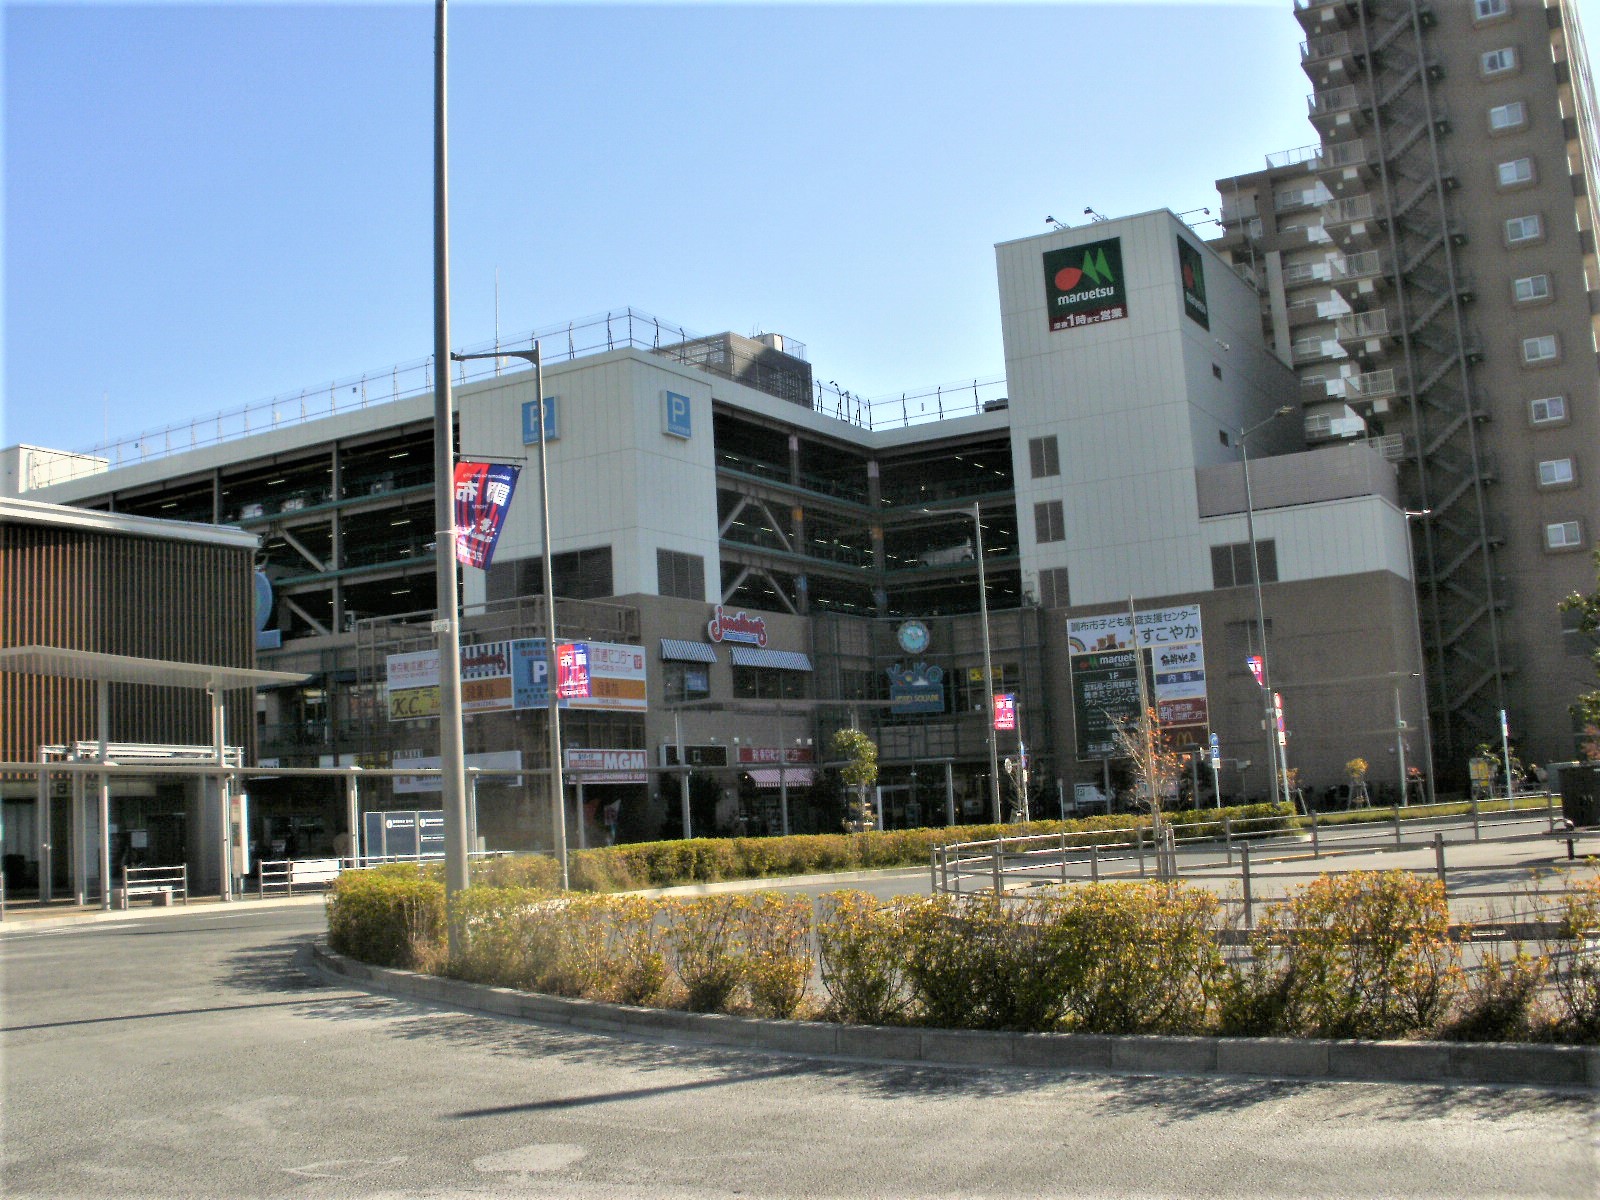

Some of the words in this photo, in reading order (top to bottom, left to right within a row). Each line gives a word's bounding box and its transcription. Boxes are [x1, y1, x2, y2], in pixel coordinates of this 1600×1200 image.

[1057, 286, 1114, 306] maruetsu
[529, 403, 548, 432] P
[671, 396, 686, 422] P
[1070, 610, 1198, 633] 調布市子ども家庭支援センター
[1140, 623, 1199, 644] すこやか
[591, 647, 632, 664] 流通センター
[533, 660, 548, 683] P
[1168, 672, 1192, 683] 内科
[390, 695, 422, 717] K.C.
[604, 752, 645, 770] MGM
